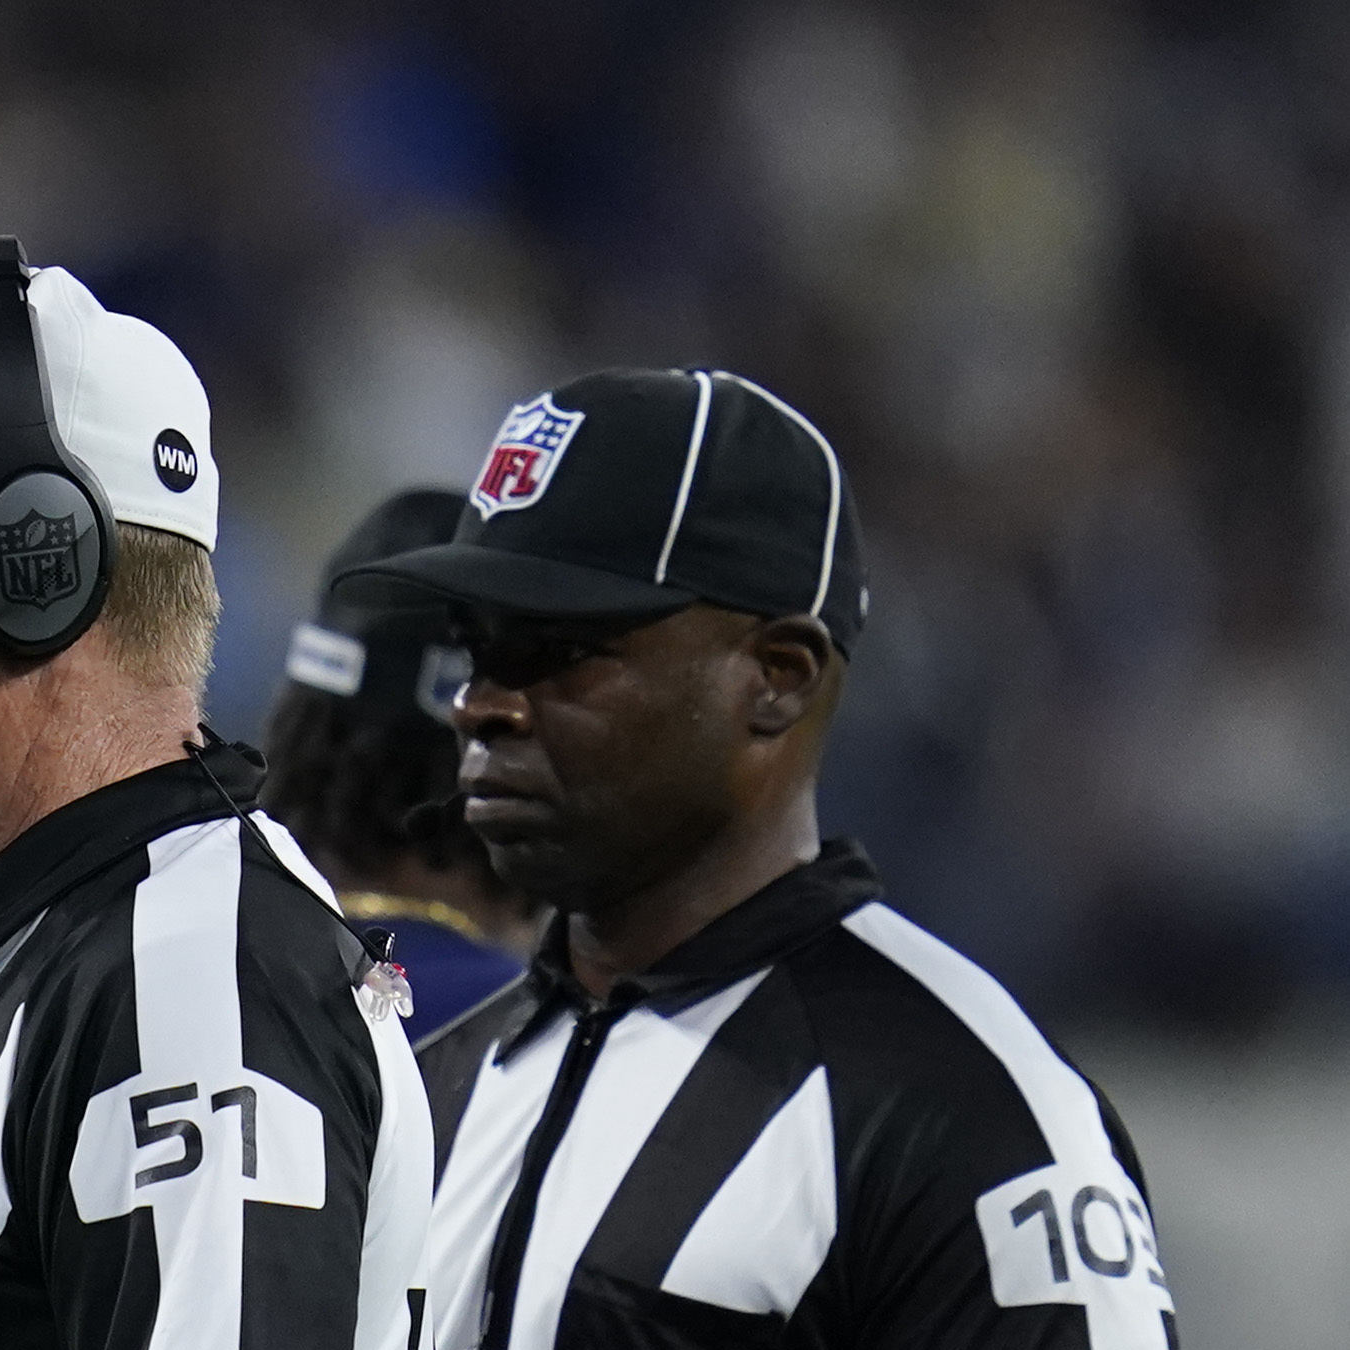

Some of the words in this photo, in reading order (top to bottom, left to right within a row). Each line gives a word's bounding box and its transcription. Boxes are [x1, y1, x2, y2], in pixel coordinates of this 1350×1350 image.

[157, 443, 195, 476] WM
[3, 554, 74, 600] NFL
[129, 1082, 257, 1189] 51
